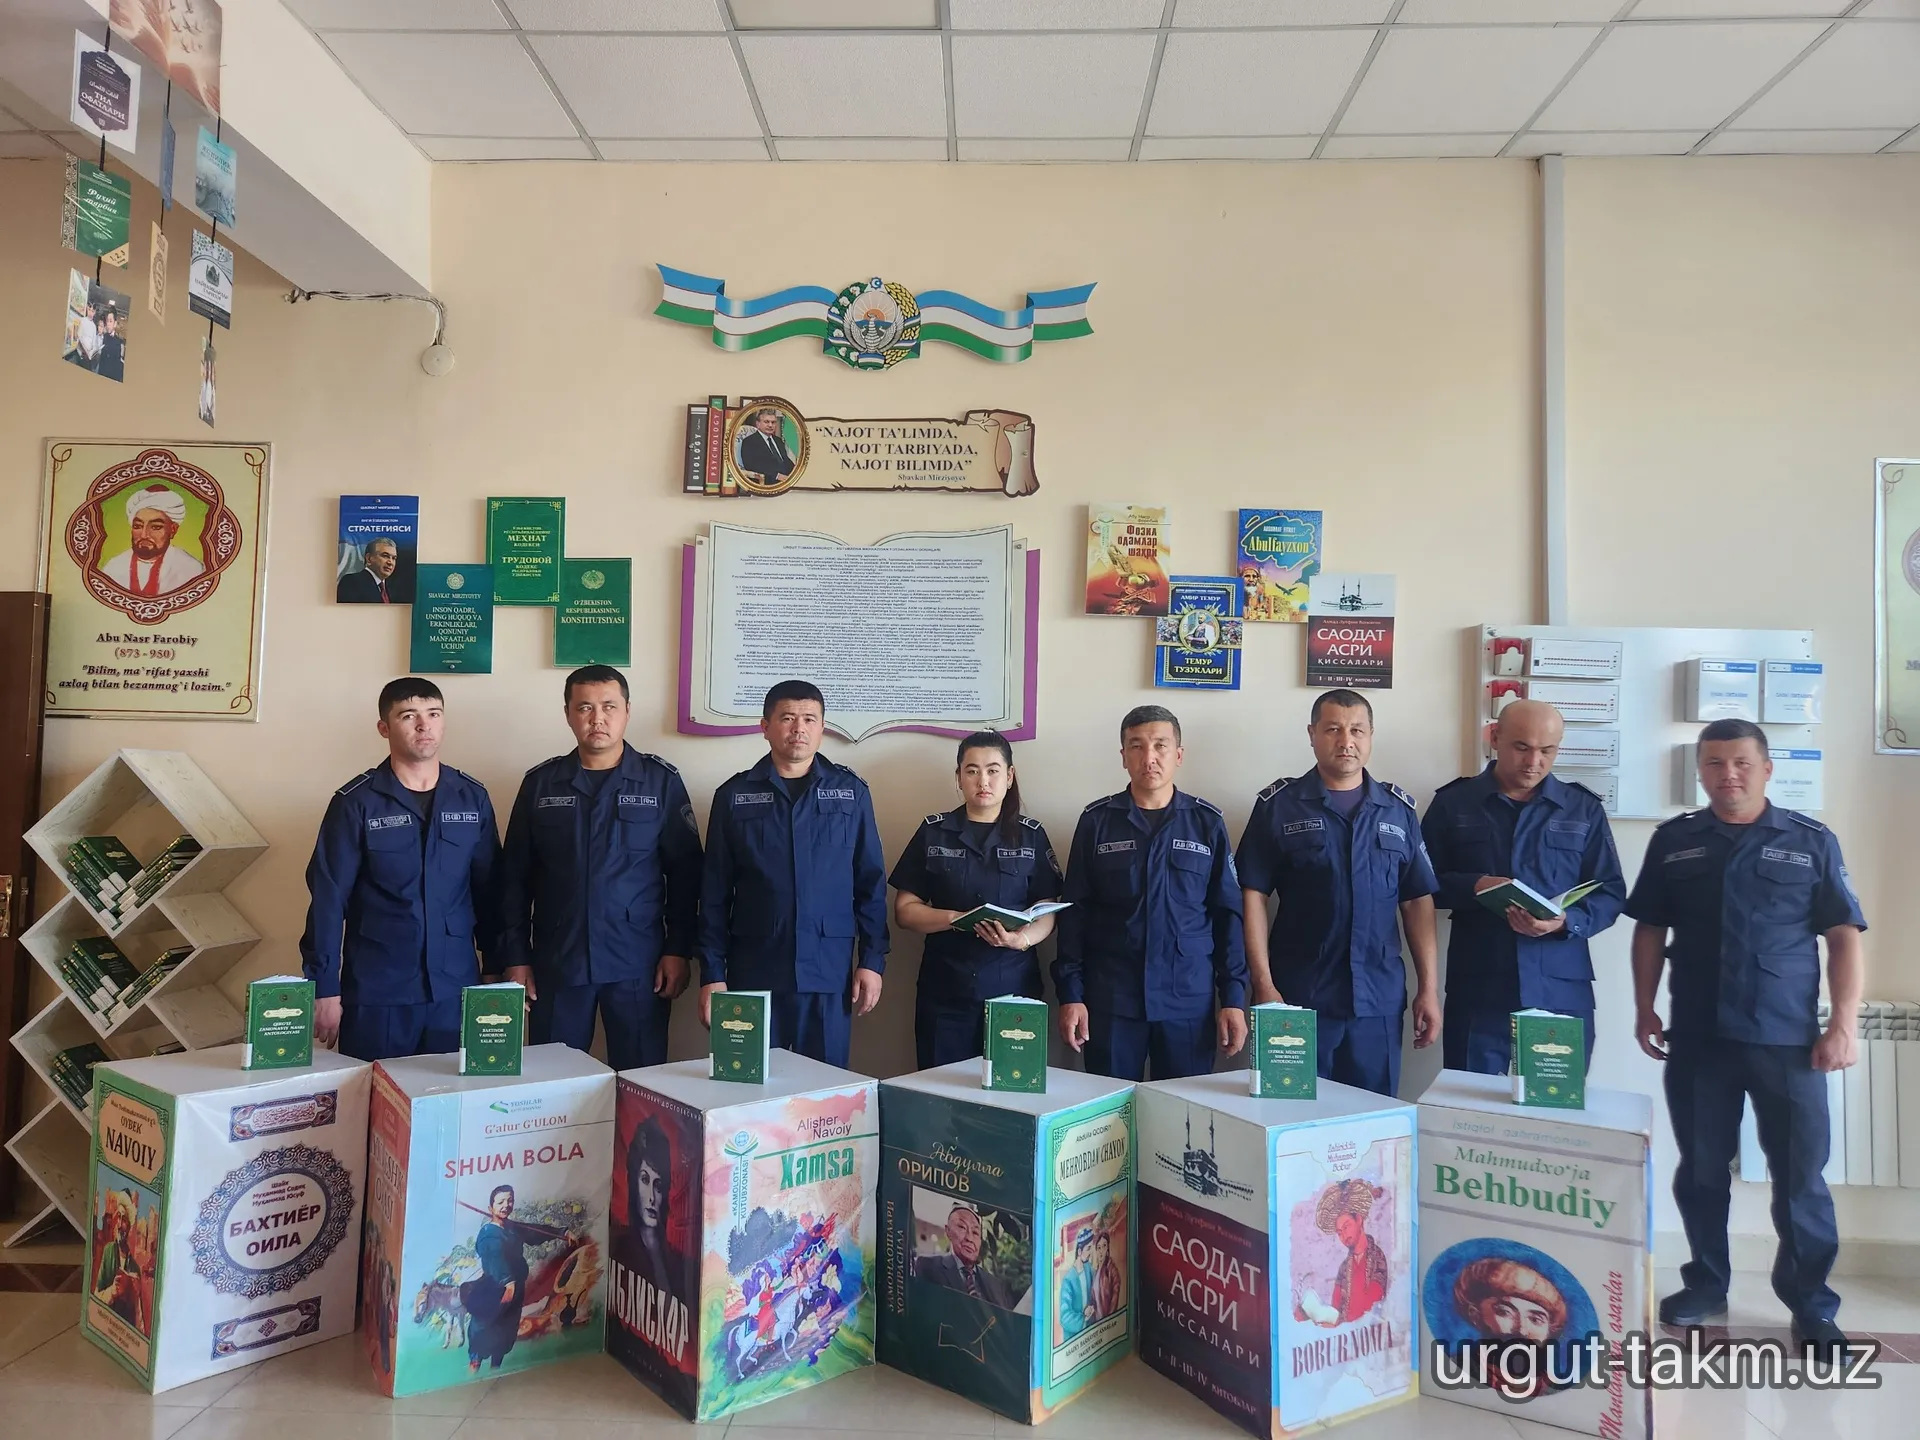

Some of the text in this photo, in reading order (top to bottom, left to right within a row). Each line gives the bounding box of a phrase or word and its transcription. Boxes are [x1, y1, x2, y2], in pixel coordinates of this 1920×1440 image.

[81, 92, 125, 120] ОФАТЛАРИ
[94, 91, 112, 106] ТИЛ
[692, 434, 702, 480] BIOLOGY
[710, 414, 720, 476] PSYCHOLOGY
[830, 442, 978, 456] NAJOT TARBIYADA,
[841, 458, 892, 470] NAJOT
[1117, 536, 1157, 548] одамлар
[1127, 525, 1157, 536] Фозил
[1249, 536, 1309, 556] Abulfayzxon
[502, 556, 552, 564] ТРУДОВОЙ
[561, 616, 625, 624] KONSTITUTSIYASI
[96, 633, 198, 647] Abu Nasr Farobiy
[1317, 628, 1386, 643] САОДАТ
[1327, 644, 1372, 656] АСРИ
[172, 668, 209, 678] yaxshi
[1174, 666, 1222, 674] ТУЗУКЛАРИ
[58, 679, 88, 691] axloq
[92, 680, 120, 689] bilan
[120, 1116, 143, 1134] OYBEK
[797, 1116, 838, 1131] Alisher
[813, 1123, 852, 1140] Navoiy
[106, 1126, 157, 1171] NAVOIY
[444, 1142, 584, 1179] SHUM BOLA
[930, 1141, 1004, 1178] Абдулла
[1060, 1136, 1125, 1181] MEHROBDAN CHAYON
[780, 1147, 854, 1190] Xamsa
[898, 1158, 970, 1192] ОРИПОВ
[740, 1159, 750, 1219] KUTUBXONASI
[1433, 1163, 1617, 1229] Behbudiy
[230, 1204, 321, 1238] БАХТИЁР
[246, 1232, 302, 1256] ОИЛА
[1152, 1223, 1261, 1296] САОДАТ
[608, 1257, 689, 1362] ИБЛИСЛАР
[1170, 1270, 1238, 1332] АСРИ
[1602, 1270, 1623, 1334] asarlar
[1157, 1300, 1260, 1369] ҚИССАЛАРИ
